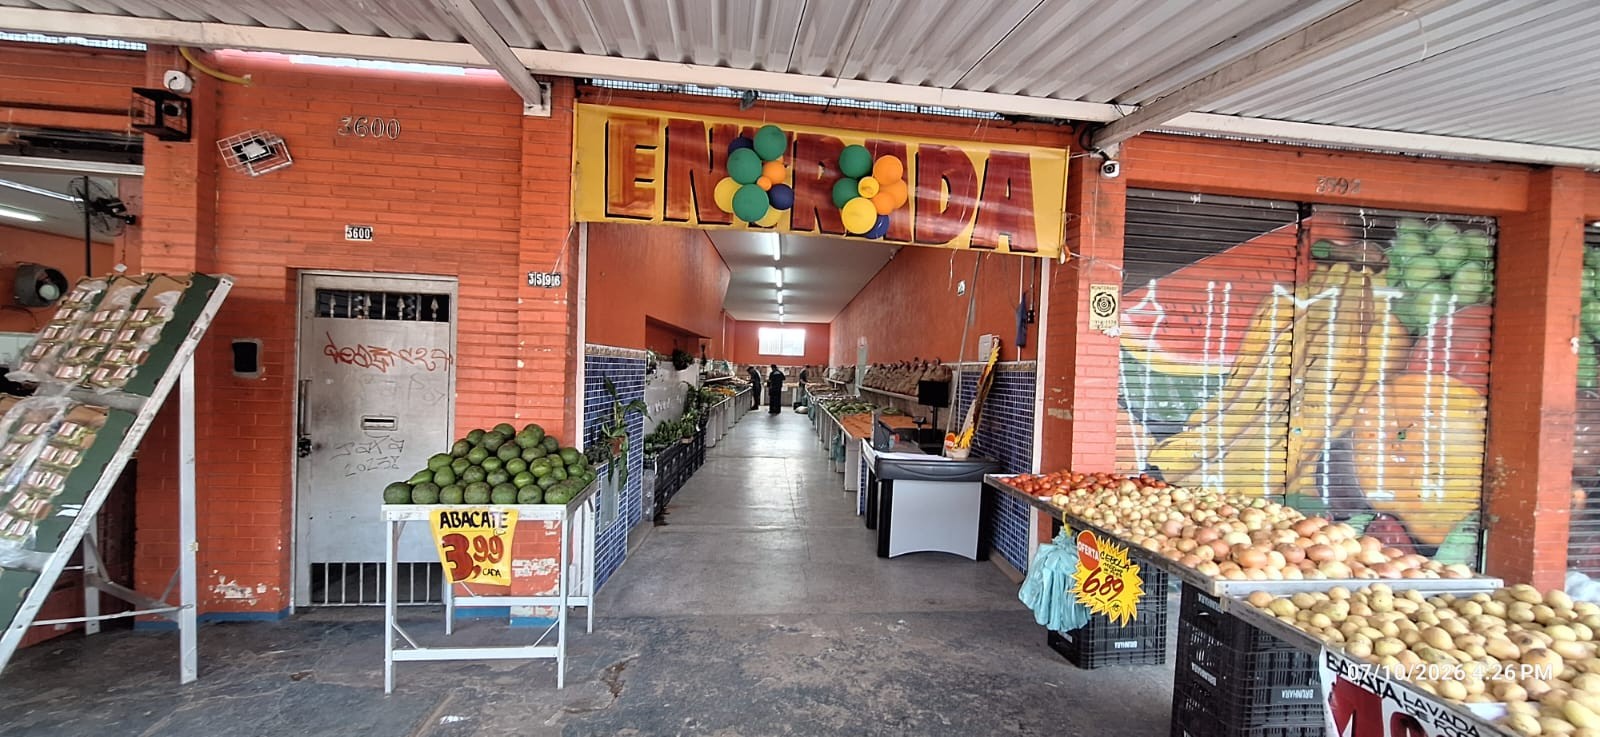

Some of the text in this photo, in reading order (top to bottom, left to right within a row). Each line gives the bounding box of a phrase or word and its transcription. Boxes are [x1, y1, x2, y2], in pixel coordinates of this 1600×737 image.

[337, 116, 401, 140] 3600
[604, 115, 1039, 254] ENRADA
[346, 226, 371, 239] 3600
[528, 273, 561, 286] 3596
[440, 511, 509, 530] ABACATE
[1077, 541, 1100, 562] OFERTA
[1100, 550, 1130, 572] CEBOLA
[482, 568, 502, 578] CADA
[1403, 691, 1480, 737] LAVADA
